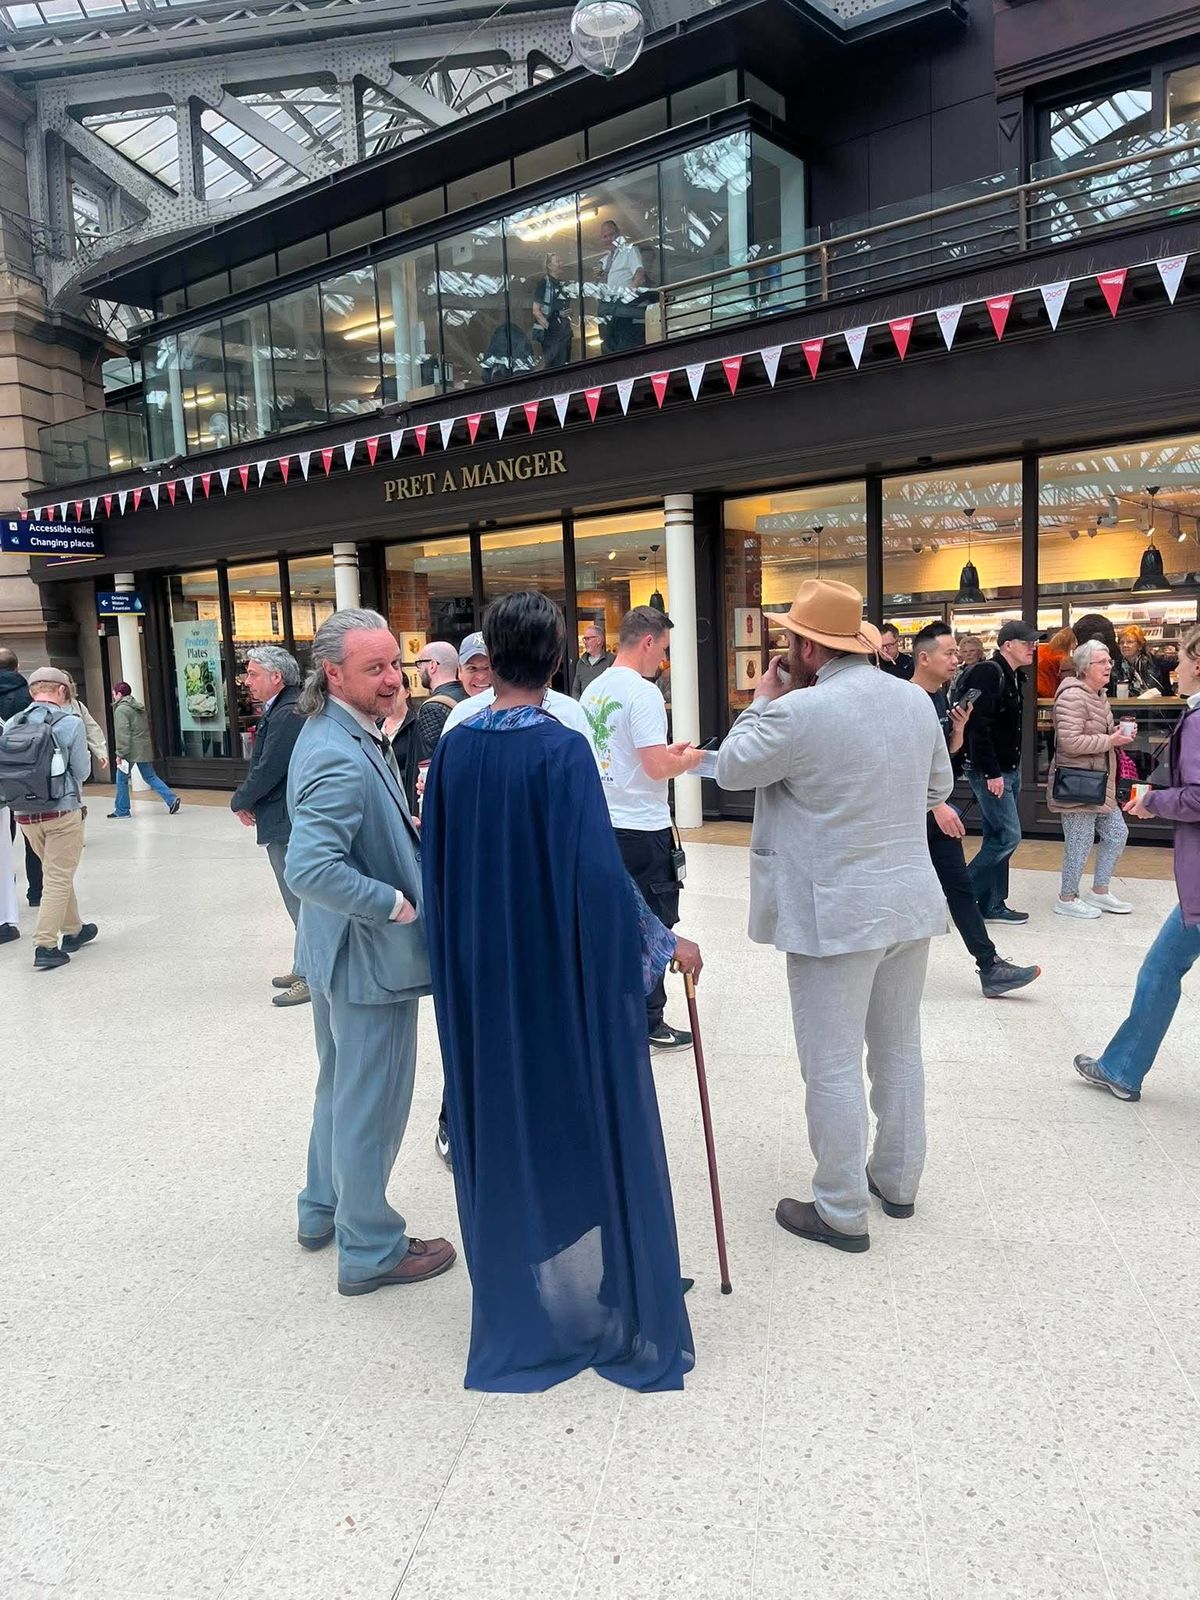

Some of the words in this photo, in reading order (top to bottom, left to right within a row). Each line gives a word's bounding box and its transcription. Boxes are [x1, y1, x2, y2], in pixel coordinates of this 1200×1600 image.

[384, 472, 436, 503] PRET
[441, 469, 457, 493] A
[461, 449, 567, 489] MANGER
[29, 523, 72, 534] Accessible
[73, 526, 94, 535] toilet
[30, 537, 69, 549] Changing
[70, 539, 95, 549] places
[187, 648, 208, 659] Plates
